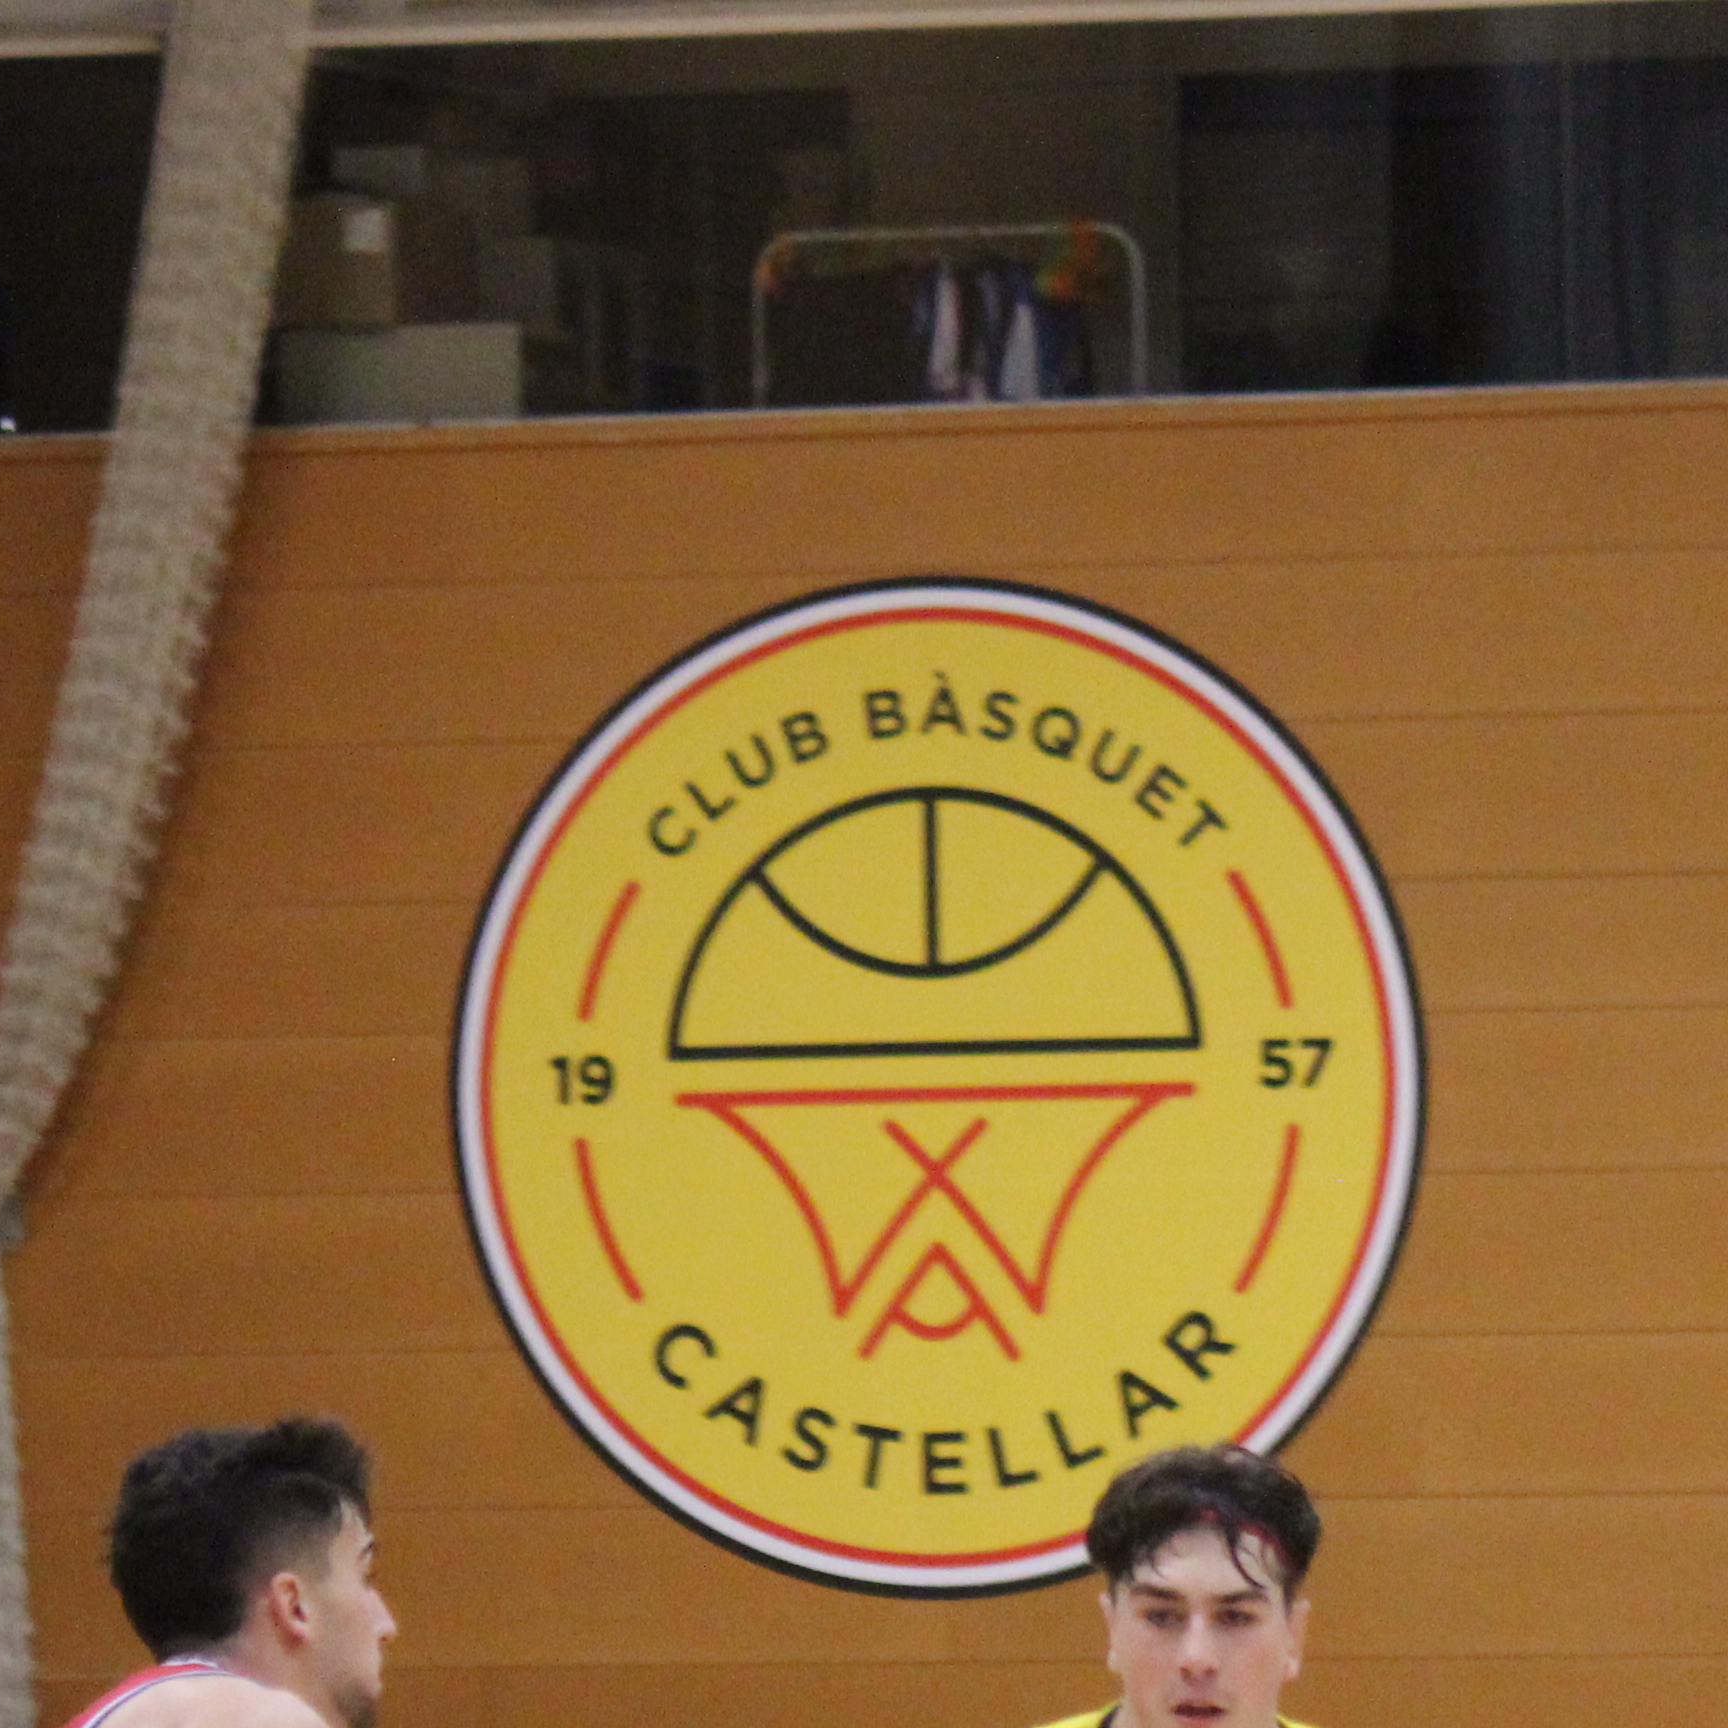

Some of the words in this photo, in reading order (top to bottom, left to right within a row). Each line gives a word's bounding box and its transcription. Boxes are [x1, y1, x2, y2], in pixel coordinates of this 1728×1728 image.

[647, 709, 831, 860] CLUB
[863, 672, 1229, 851] BÀSQUET
[549, 1054, 615, 1106] 19
[1257, 1037, 1335, 1091] 57
[653, 1307, 1239, 1496] CASTELLAR
